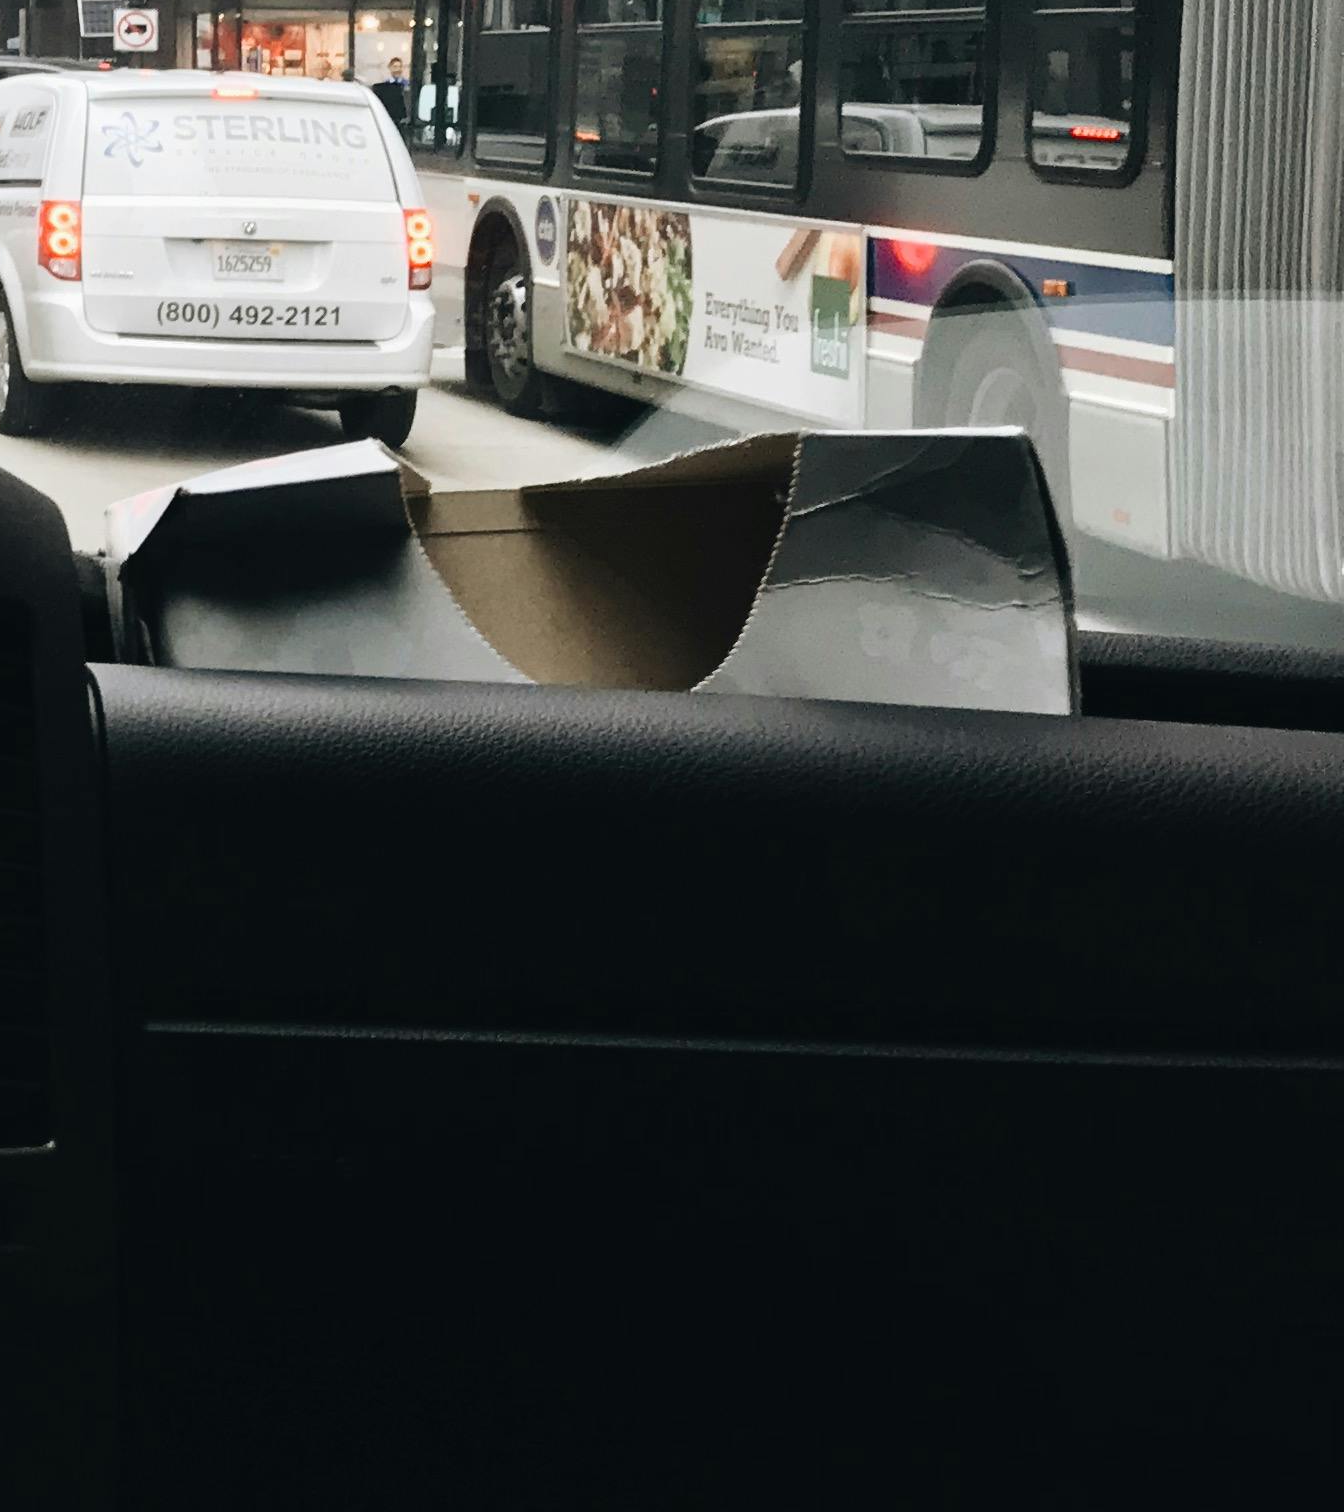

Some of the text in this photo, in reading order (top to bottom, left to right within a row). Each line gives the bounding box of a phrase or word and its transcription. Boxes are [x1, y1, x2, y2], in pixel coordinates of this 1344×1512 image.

[173, 115, 368, 149] STERLING
[156, 301, 343, 330] (800) 492-2121
[705, 291, 799, 334] Everything You
[704, 325, 728, 352] Avo
